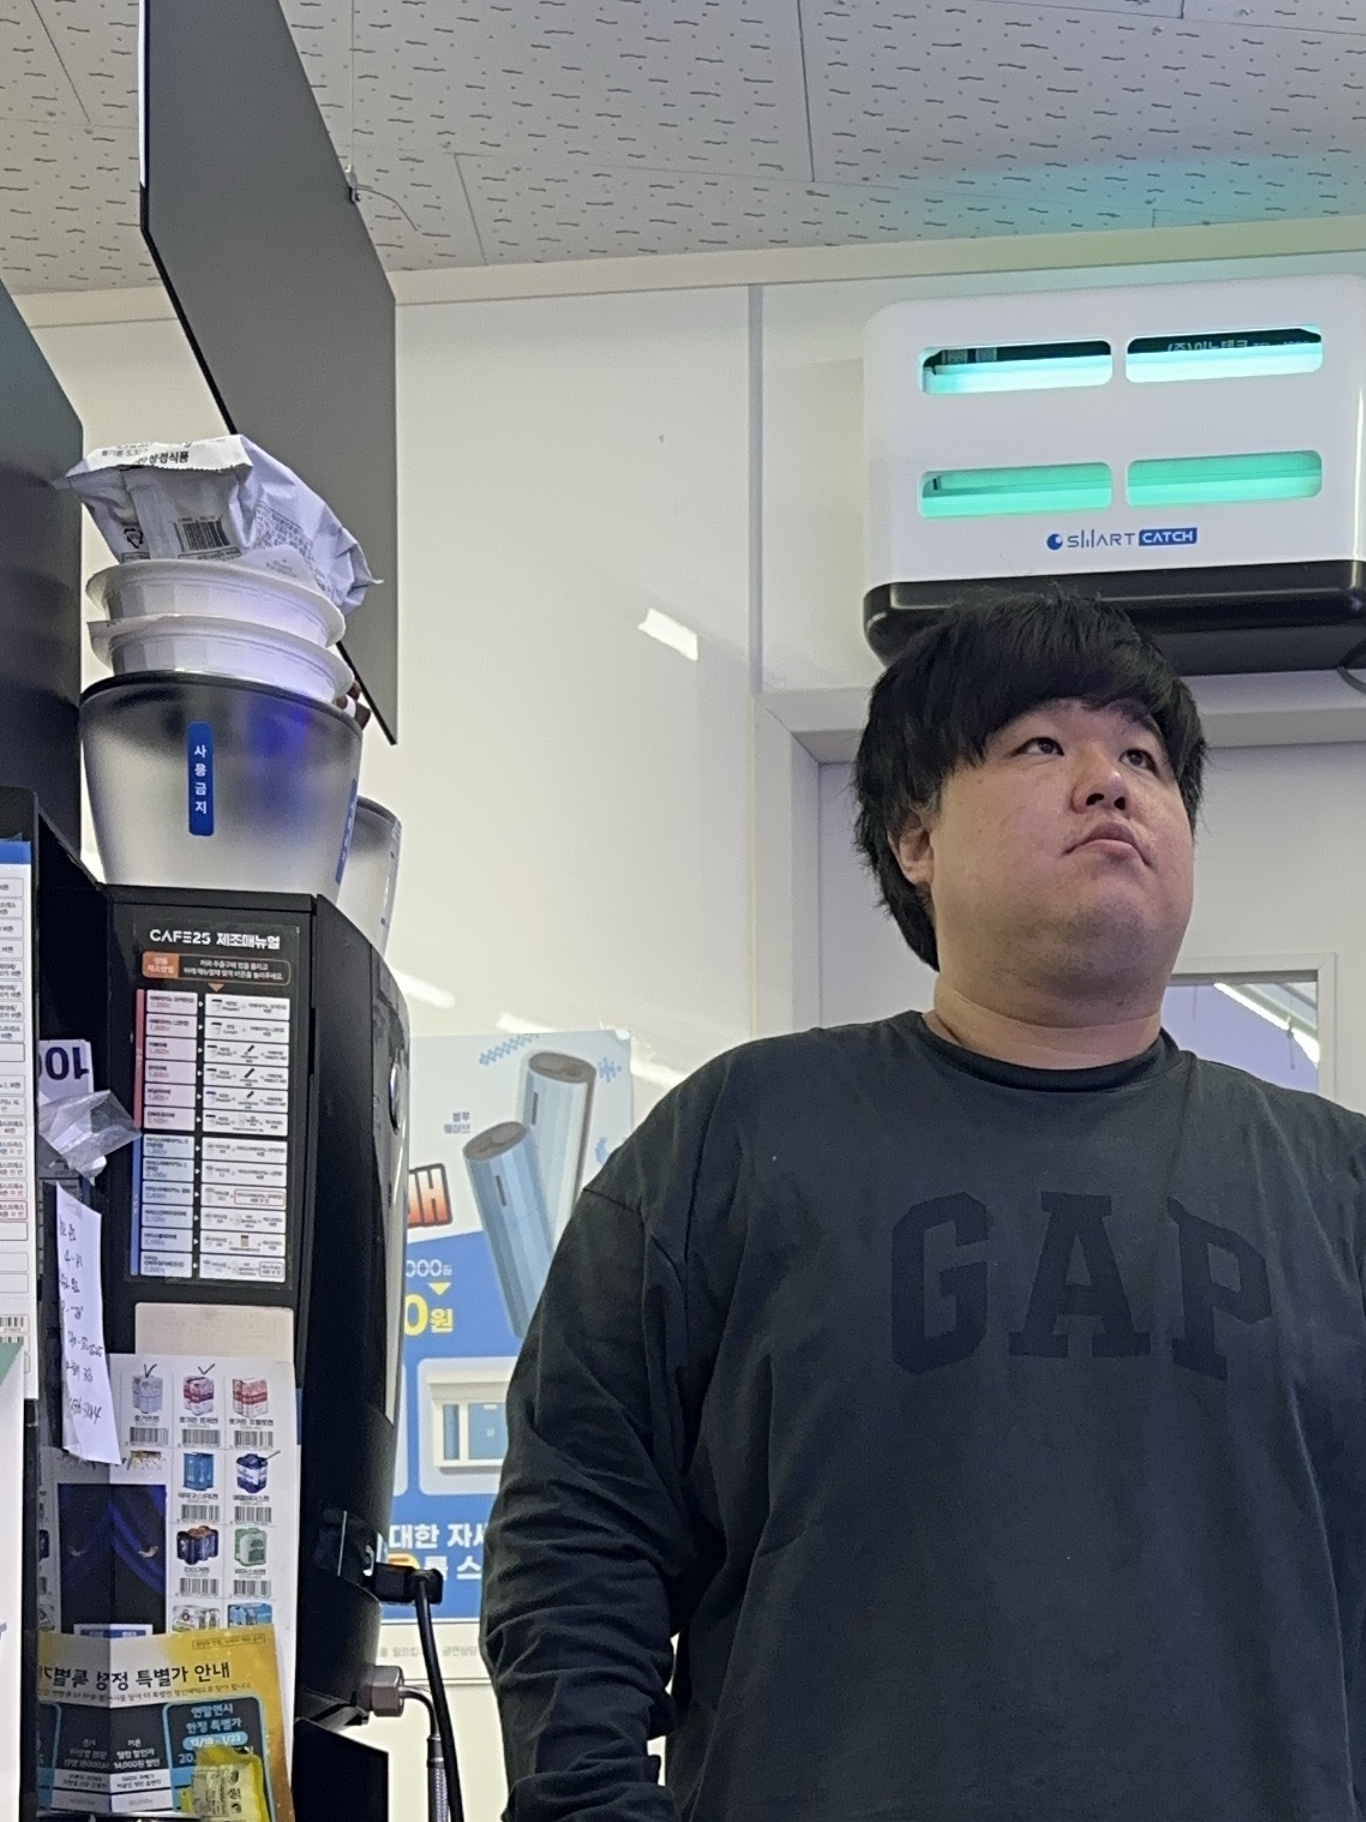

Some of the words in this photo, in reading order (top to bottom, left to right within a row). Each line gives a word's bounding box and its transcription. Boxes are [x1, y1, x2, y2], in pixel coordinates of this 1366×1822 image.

[1142, 528, 1197, 547] CATCH
[193, 744, 208, 816] 사용금지
[149, 929, 212, 946] CAFE25
[891, 1190, 1272, 1381] GAP
[135, 1665, 189, 1688] 특별가
[193, 1661, 231, 1683] 안내
